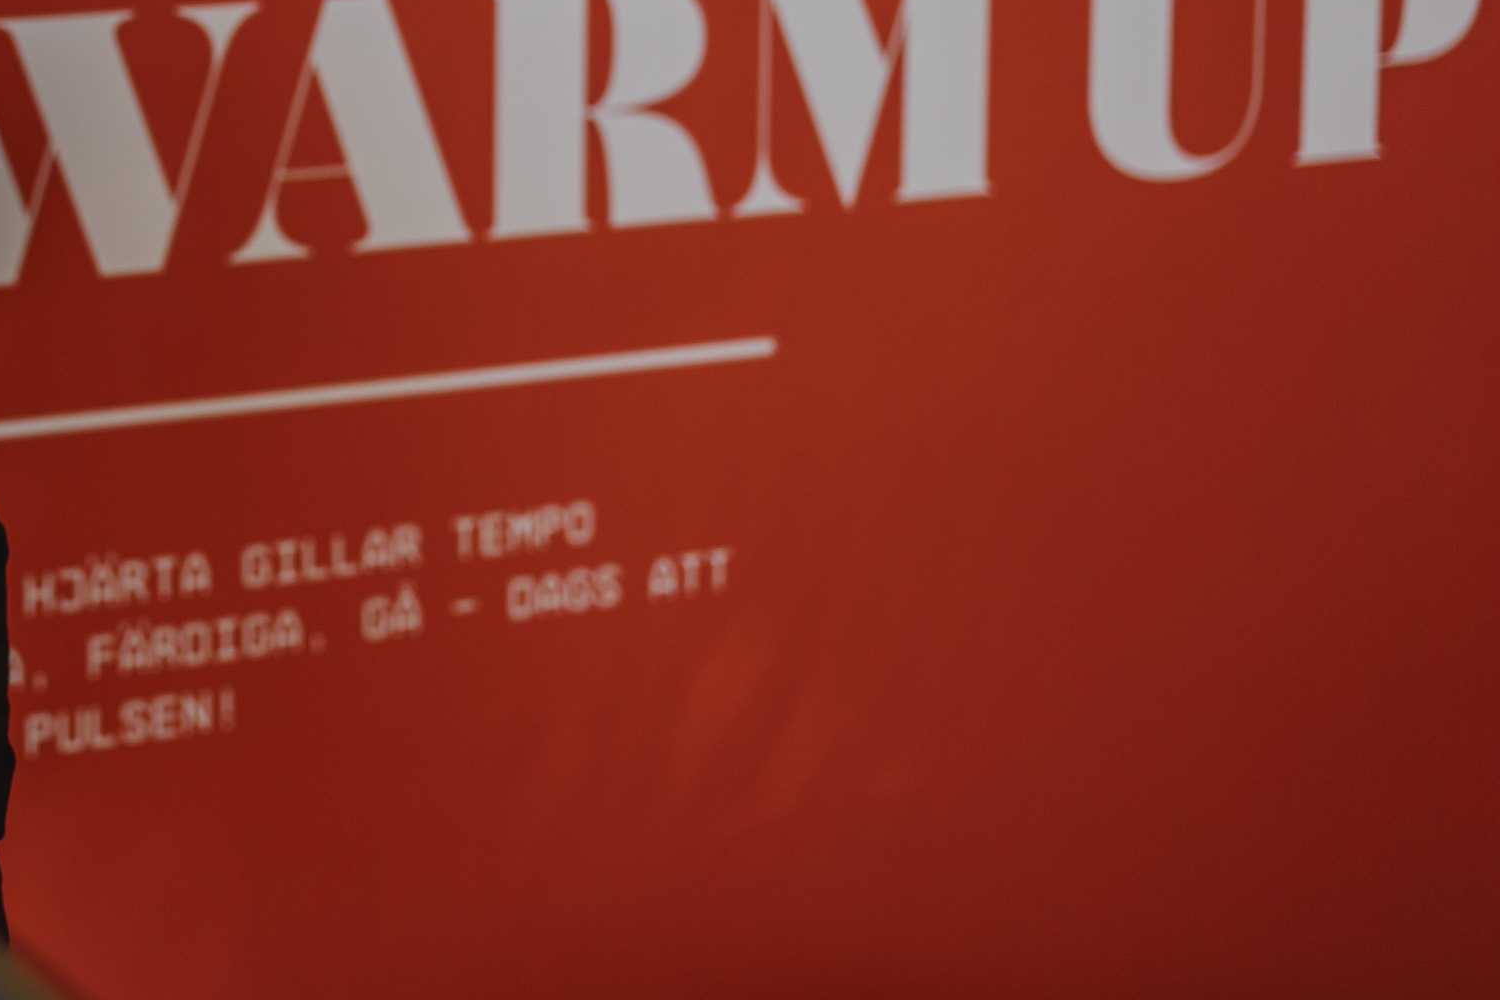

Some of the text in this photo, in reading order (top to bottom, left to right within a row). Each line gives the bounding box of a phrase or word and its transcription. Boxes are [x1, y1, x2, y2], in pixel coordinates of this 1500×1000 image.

[22, 498, 597, 617] HJÄRTA GILLAR TEMPO
[360, 580, 424, 643] GÅ
[505, 561, 625, 623] DAGS
[646, 546, 734, 601] ATT
[22, 688, 237, 758] PULSEN!
